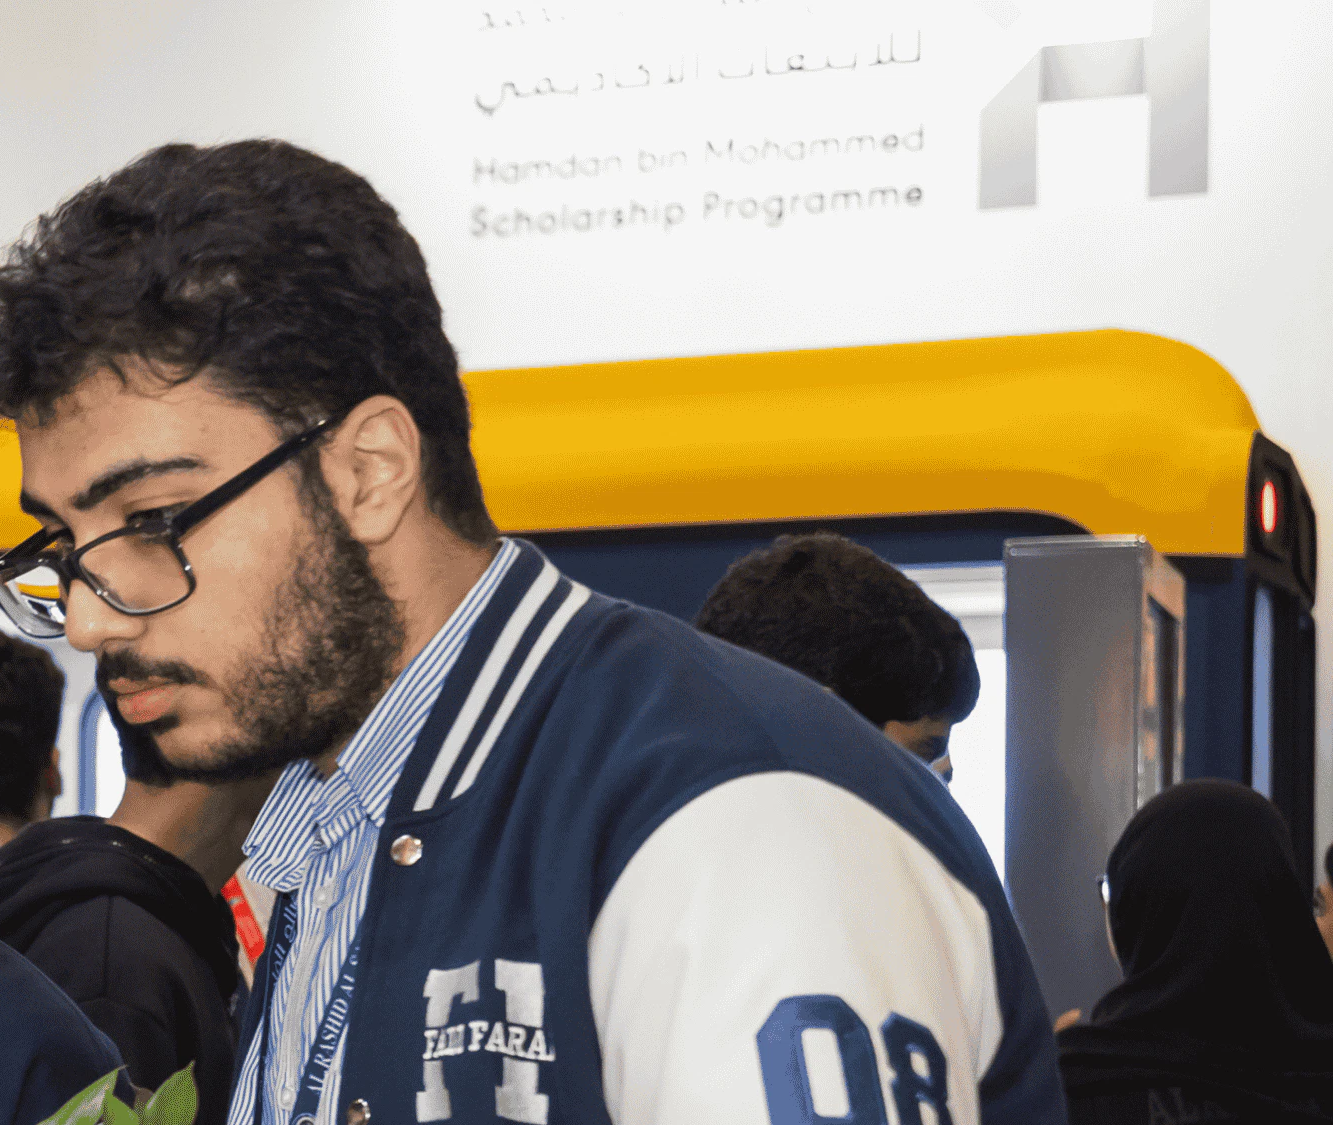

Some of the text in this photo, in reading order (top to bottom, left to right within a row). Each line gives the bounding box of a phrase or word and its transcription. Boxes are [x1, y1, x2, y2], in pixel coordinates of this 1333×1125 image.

[472, 124, 924, 187] Hamdan bin Mohammed
[469, 183, 923, 238] Scholarship Programme
[313, 998, 349, 1069] RASHID
[468, 1020, 556, 1063] FARA
